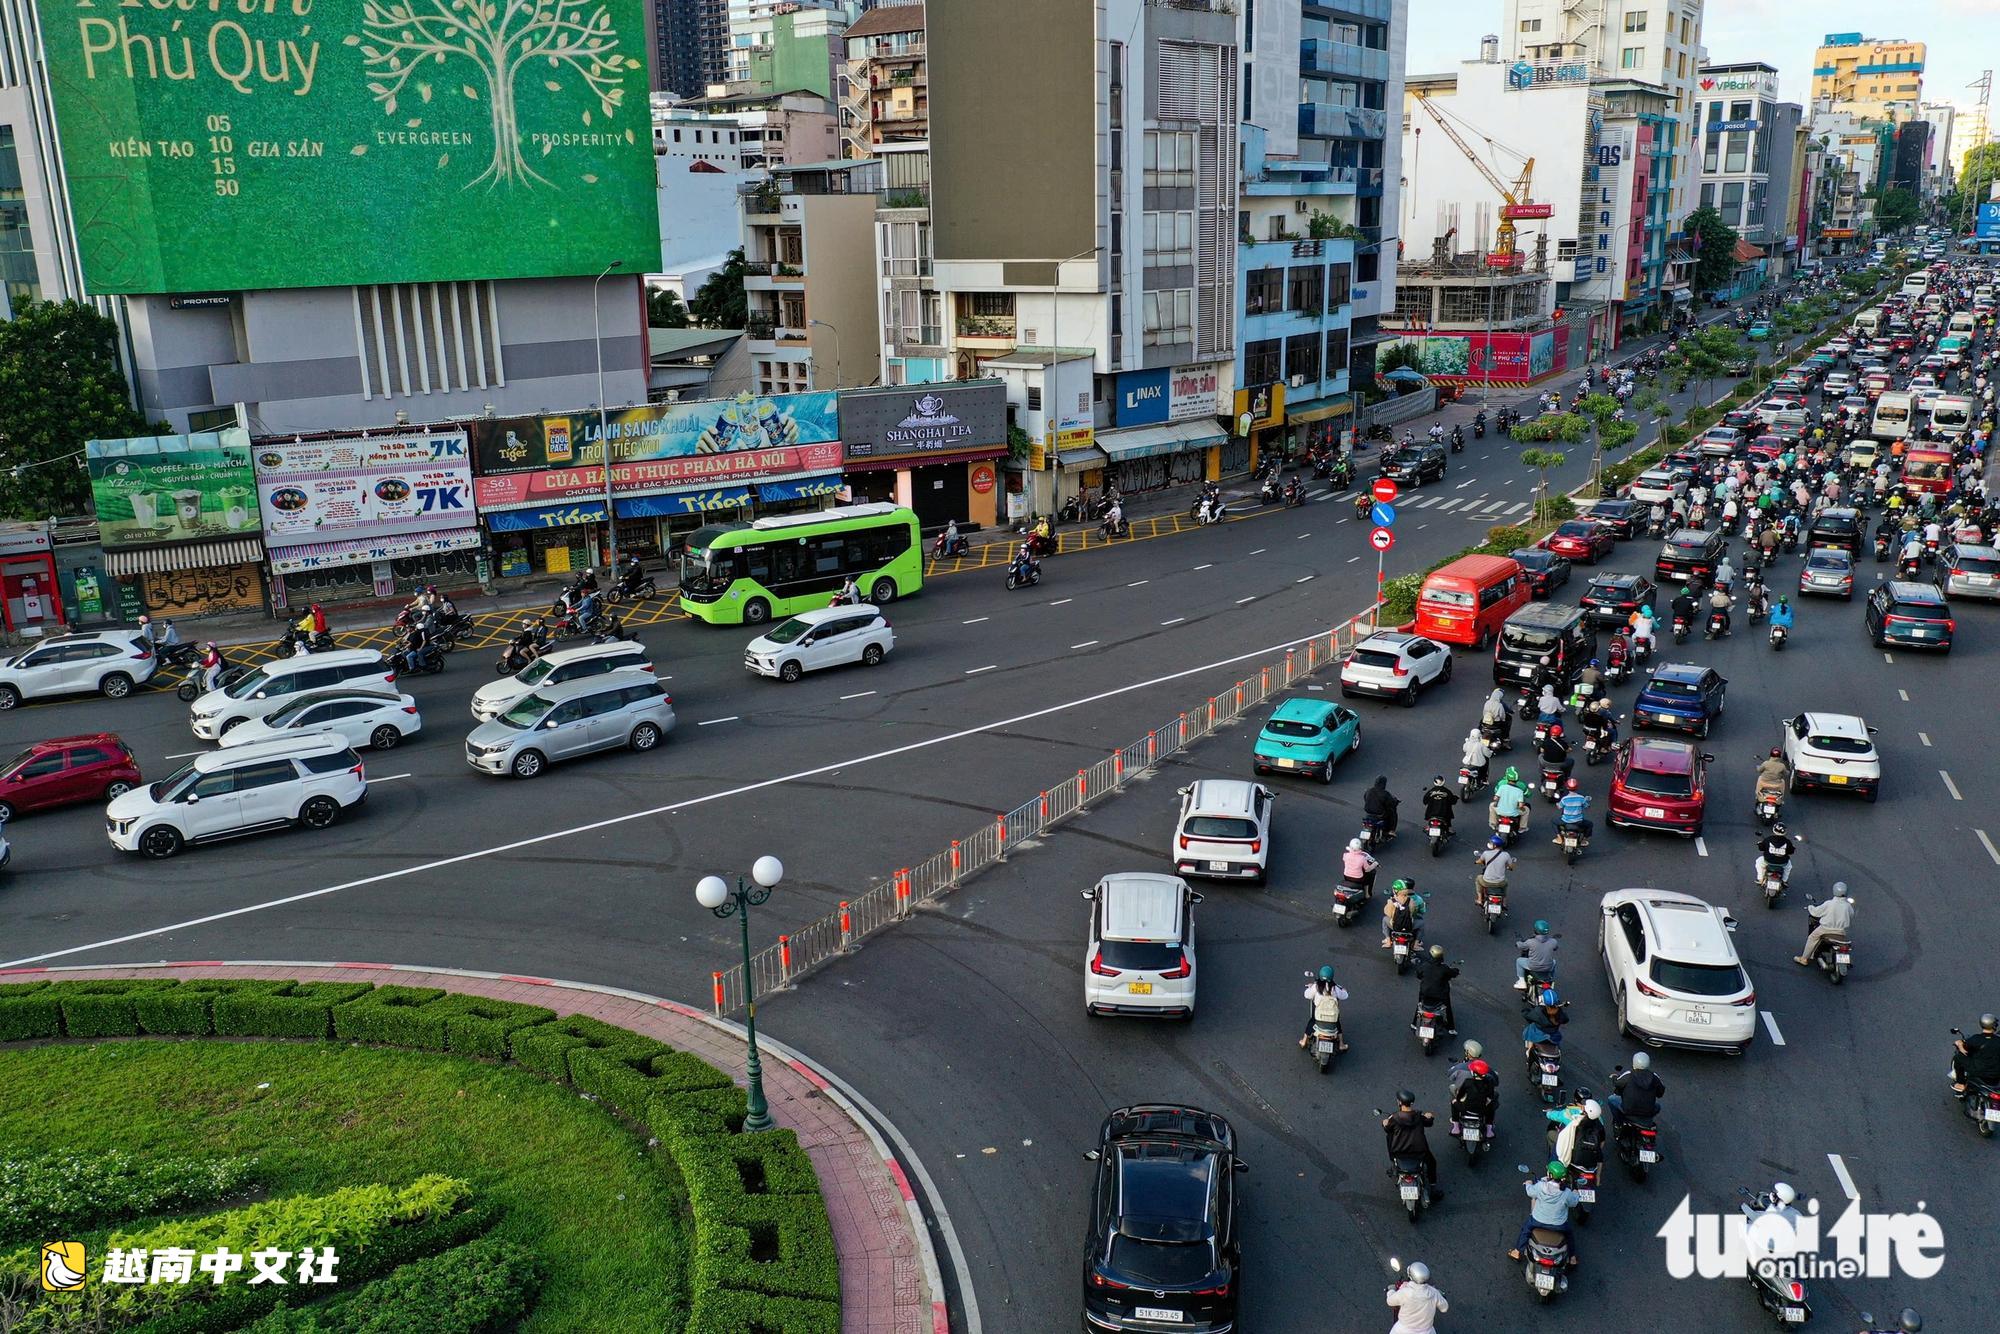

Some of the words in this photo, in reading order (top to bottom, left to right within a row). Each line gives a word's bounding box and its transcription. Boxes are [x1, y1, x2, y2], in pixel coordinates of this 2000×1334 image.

[79, 15, 195, 80] Phú
[208, 20, 320, 95] Quý
[1716, 80, 1757, 90] VPBank
[207, 115, 232, 132] 05
[1724, 122, 1746, 130] pascal
[208, 136, 233, 153] 10
[377, 132, 472, 145] EVERGREEN
[532, 133, 622, 146] PROSPERITY
[158, 141, 195, 160] TẠO
[247, 141, 281, 157] GIA
[287, 139, 324, 157] SẢN
[211, 157, 236, 175] 15
[215, 179, 239, 196] 50
[183, 297, 229, 305] PROWTECH
[1137, 386, 1161, 400] INAX
[550, 435, 569, 445] COOL
[886, 428, 945, 442] SHANGHAI
[951, 425, 972, 436] TEA
[430, 439, 464, 457] 7K
[499, 448, 527, 462] Tiger
[549, 444, 569, 454] PACK
[151, 464, 182, 474] COFFEE
[189, 463, 206, 471] TEA
[214, 459, 248, 468] MATCHA
[735, 453, 759, 468] HÀ
[761, 451, 786, 467] NỘI
[565, 486, 601, 496] CHUYÊN
[416, 486, 464, 511] 7K
[434, 539, 452, 549] 7K
[369, 548, 387, 558] 7K
[302, 557, 320, 567] 7K
